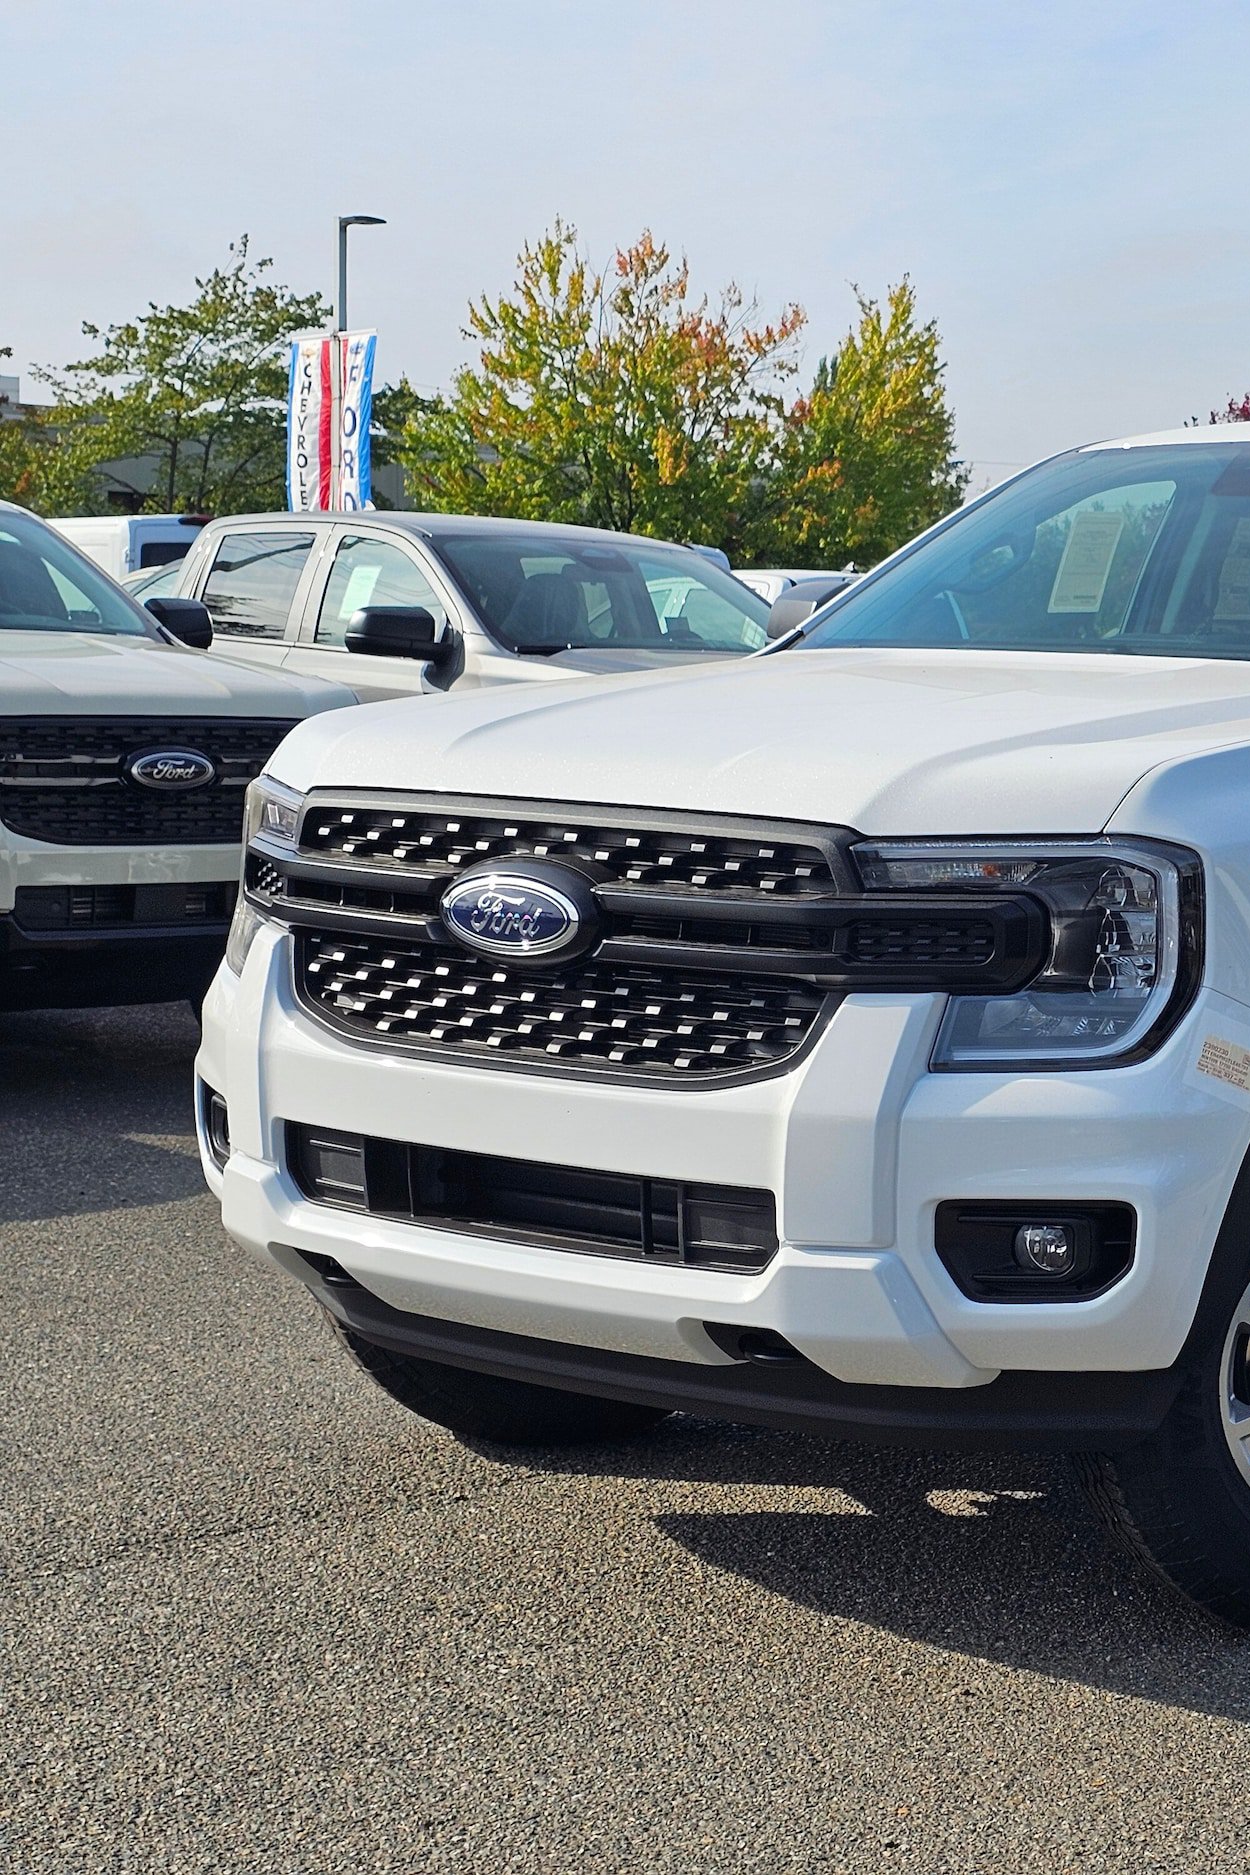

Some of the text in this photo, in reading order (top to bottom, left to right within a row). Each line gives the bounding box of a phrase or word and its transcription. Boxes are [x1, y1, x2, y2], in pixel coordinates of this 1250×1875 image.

[296, 363, 312, 512] CHEVROLE
[343, 366, 359, 511] FORD
[153, 759, 196, 780] Ford
[470, 891, 543, 938] Ford
